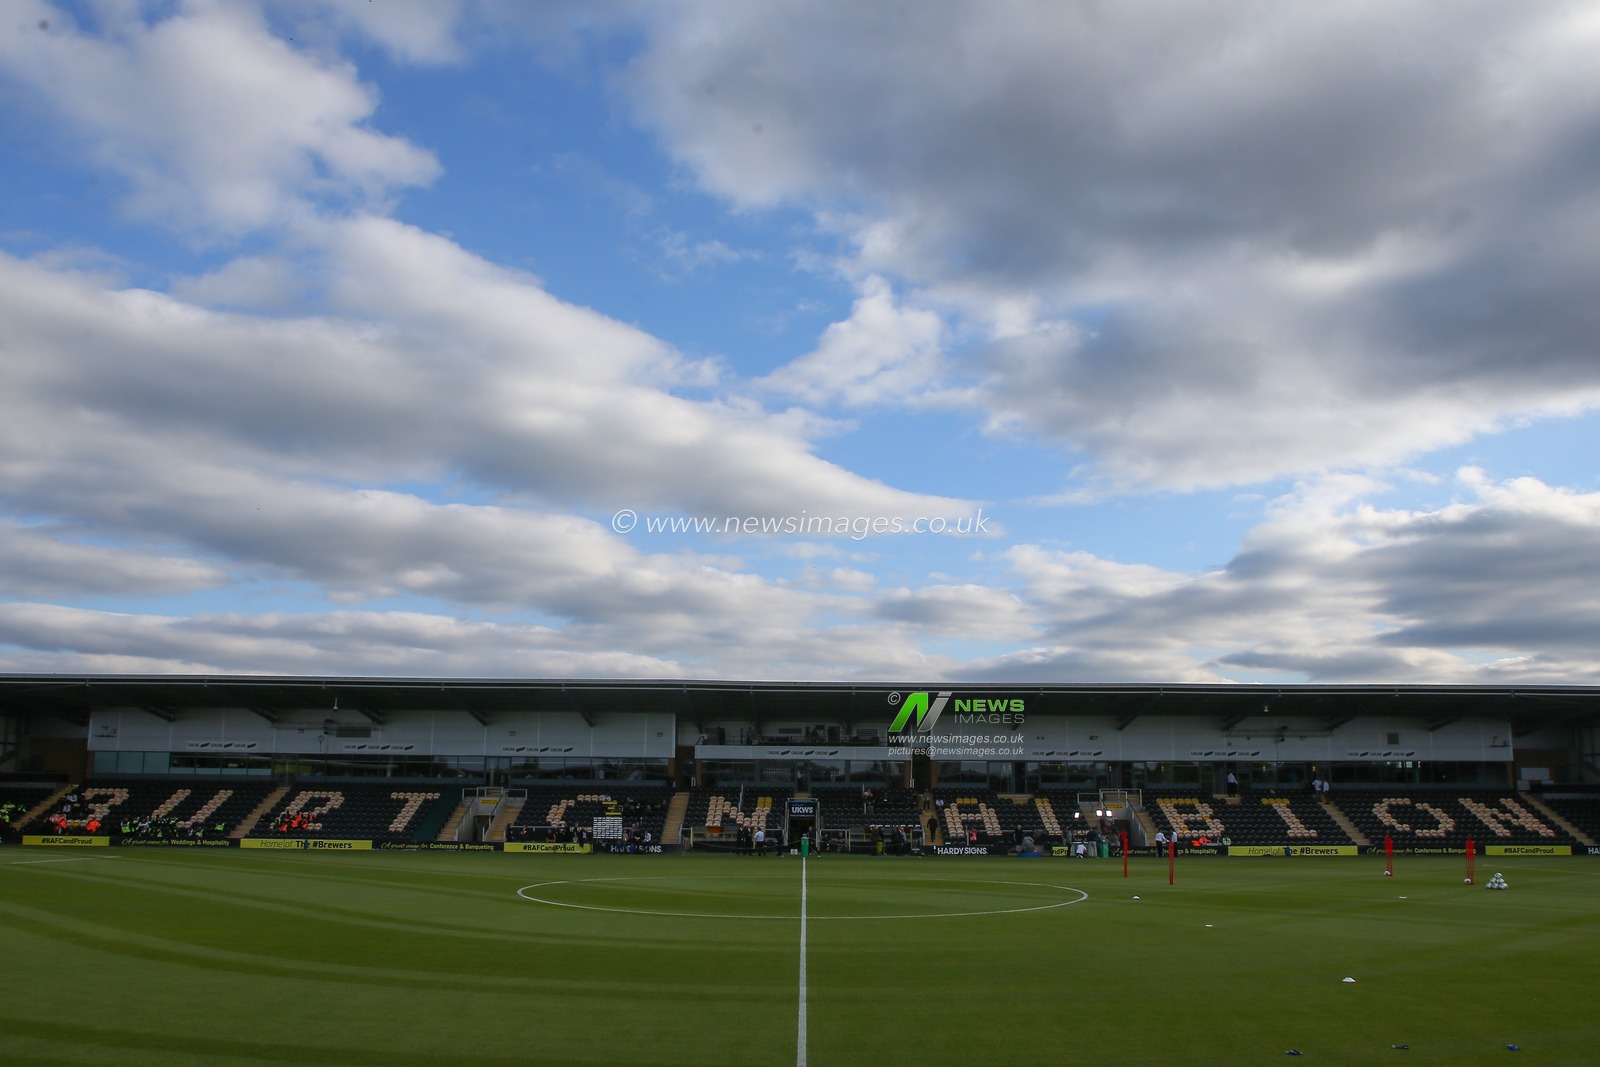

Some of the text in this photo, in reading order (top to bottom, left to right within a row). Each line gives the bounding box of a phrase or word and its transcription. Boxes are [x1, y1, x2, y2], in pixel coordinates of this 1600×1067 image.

[792, 806, 813, 814] UKWS
[260, 840, 283, 848] Home
[285, 840, 293, 848] of
[312, 840, 352, 849] #Brewers
[465, 843, 494, 851] Banqueting
[937, 847, 987, 855] HARDY SIGNS
[1248, 847, 1270, 855] Home
[1273, 847, 1280, 855] of
[1299, 847, 1339, 855] #Brewers
